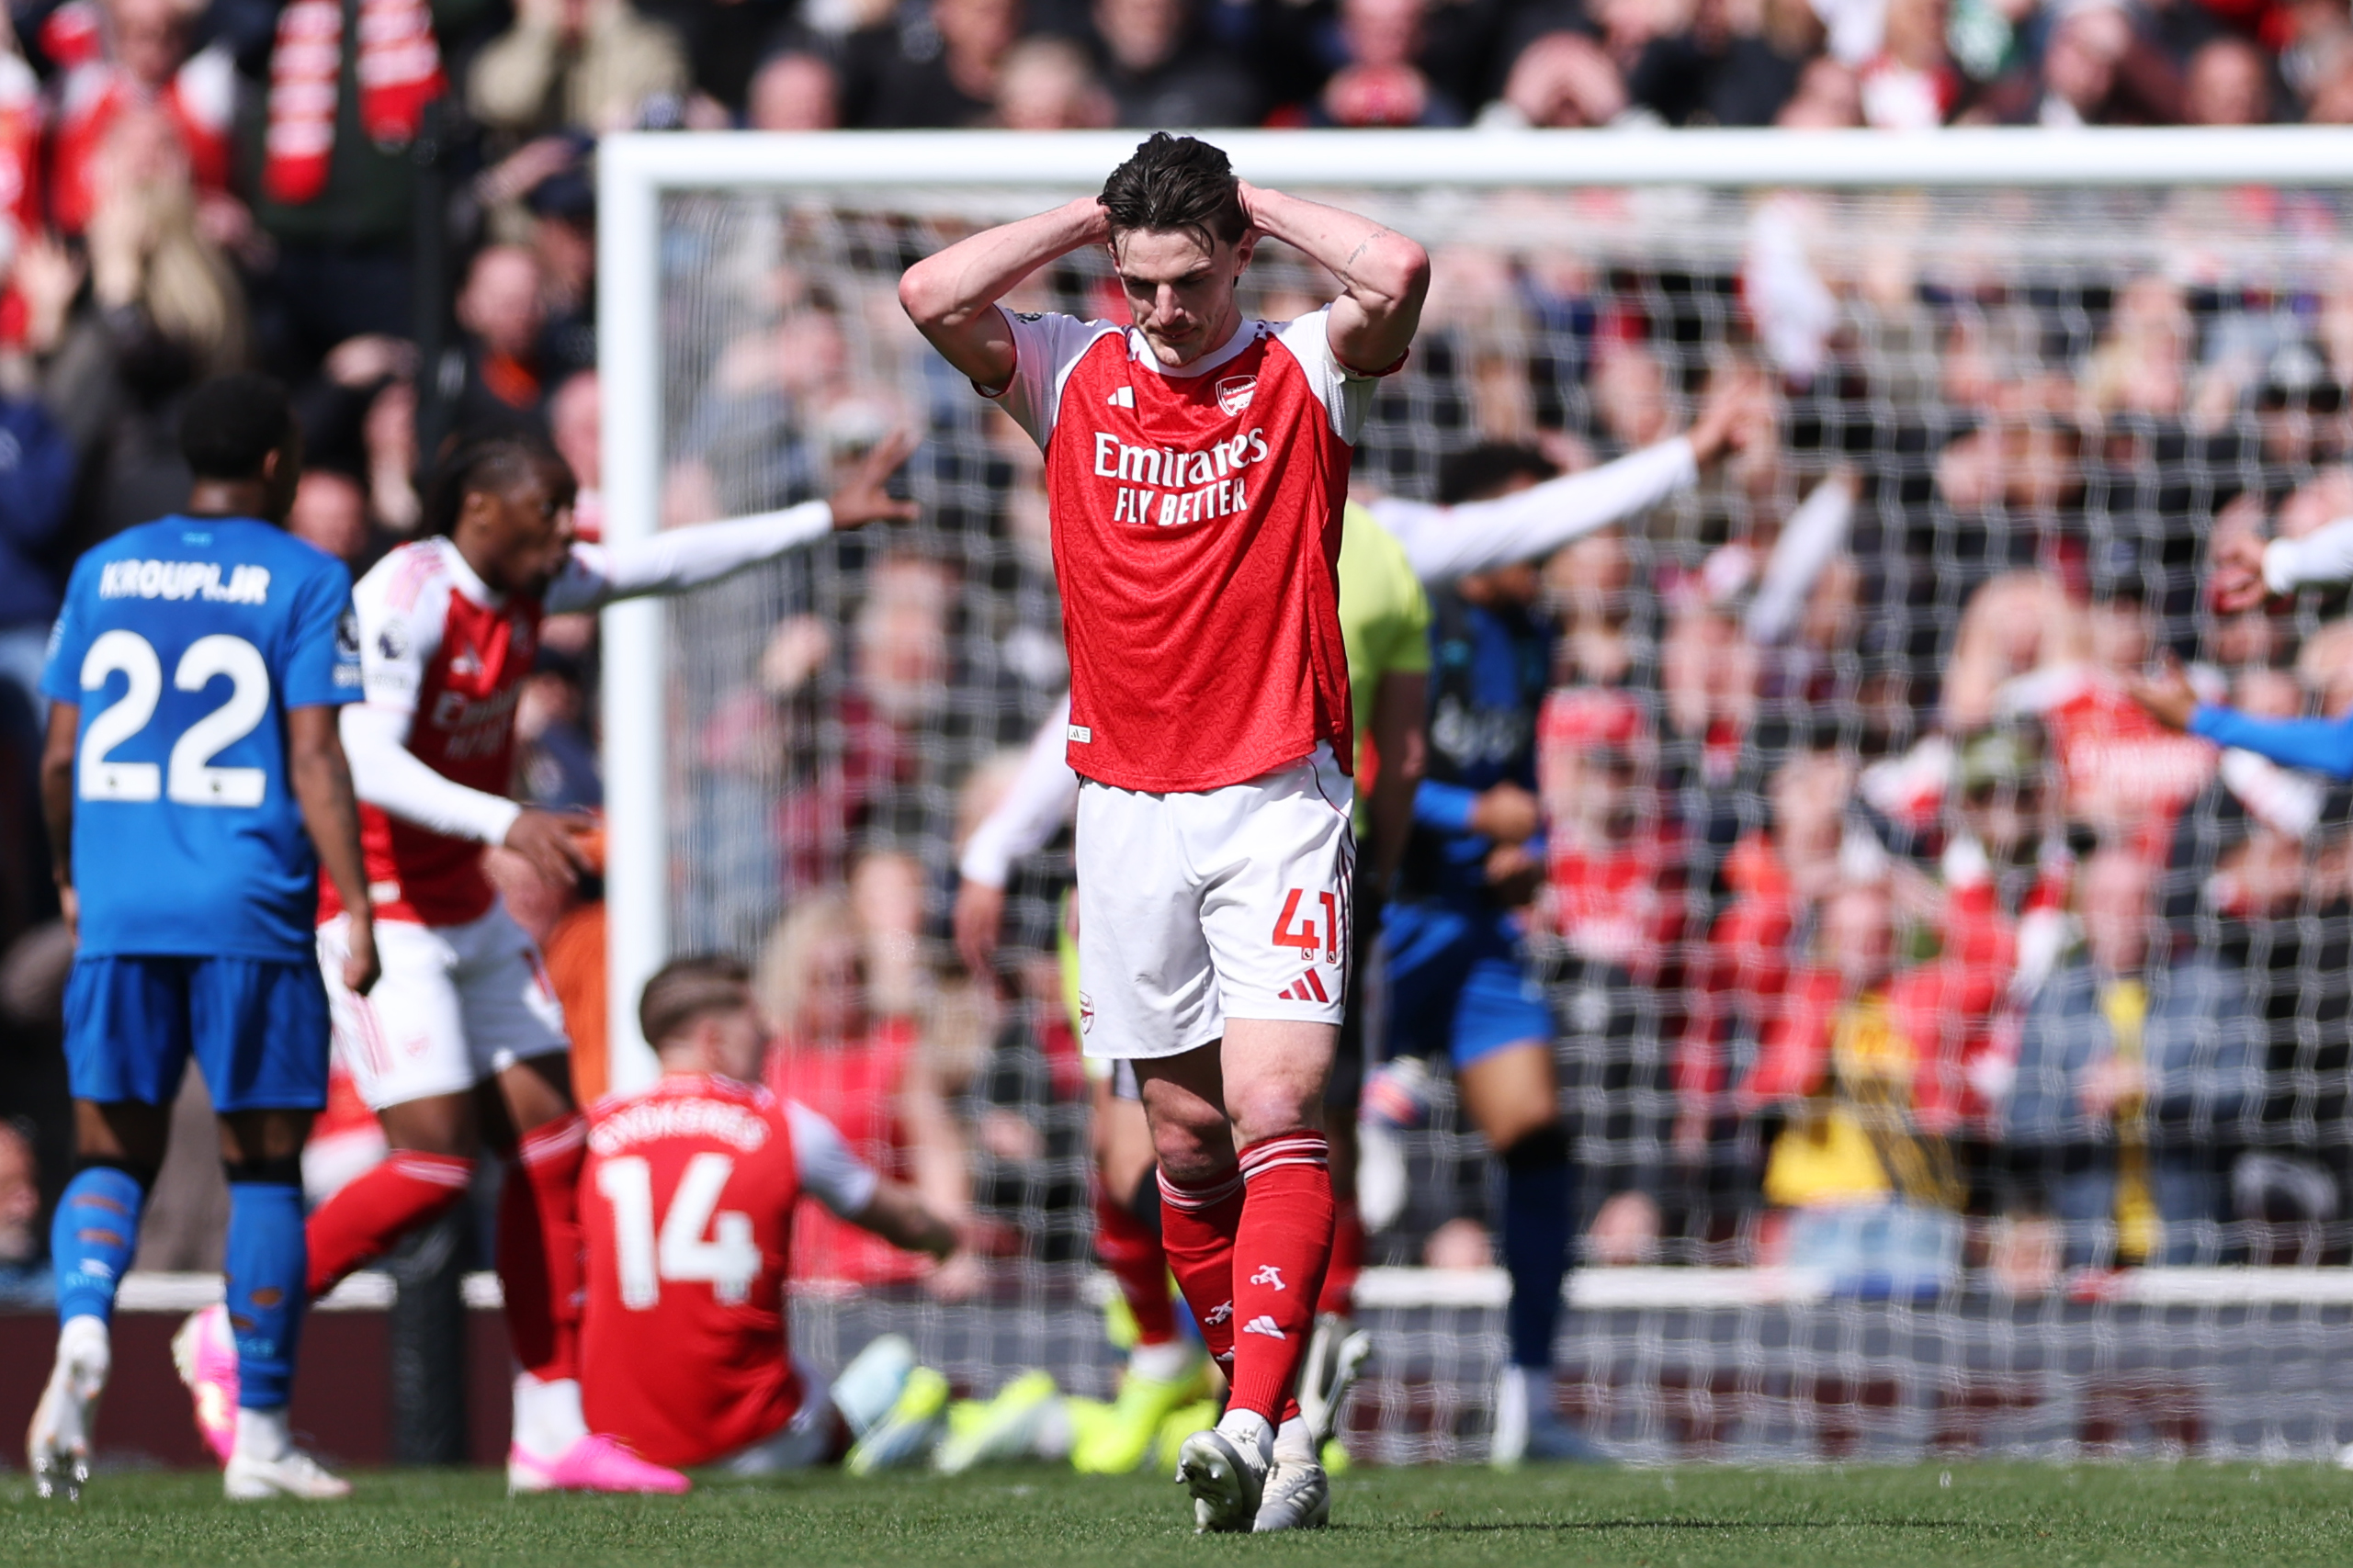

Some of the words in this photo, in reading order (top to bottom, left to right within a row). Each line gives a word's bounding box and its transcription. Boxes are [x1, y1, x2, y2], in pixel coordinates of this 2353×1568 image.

[1094, 428, 1268, 488] Emirates
[1114, 486, 1155, 525] FLY
[1158, 477, 1248, 526] BETTER
[77, 628, 270, 809] 22
[1272, 887, 1337, 964] 41
[595, 1152, 764, 1311] 14
